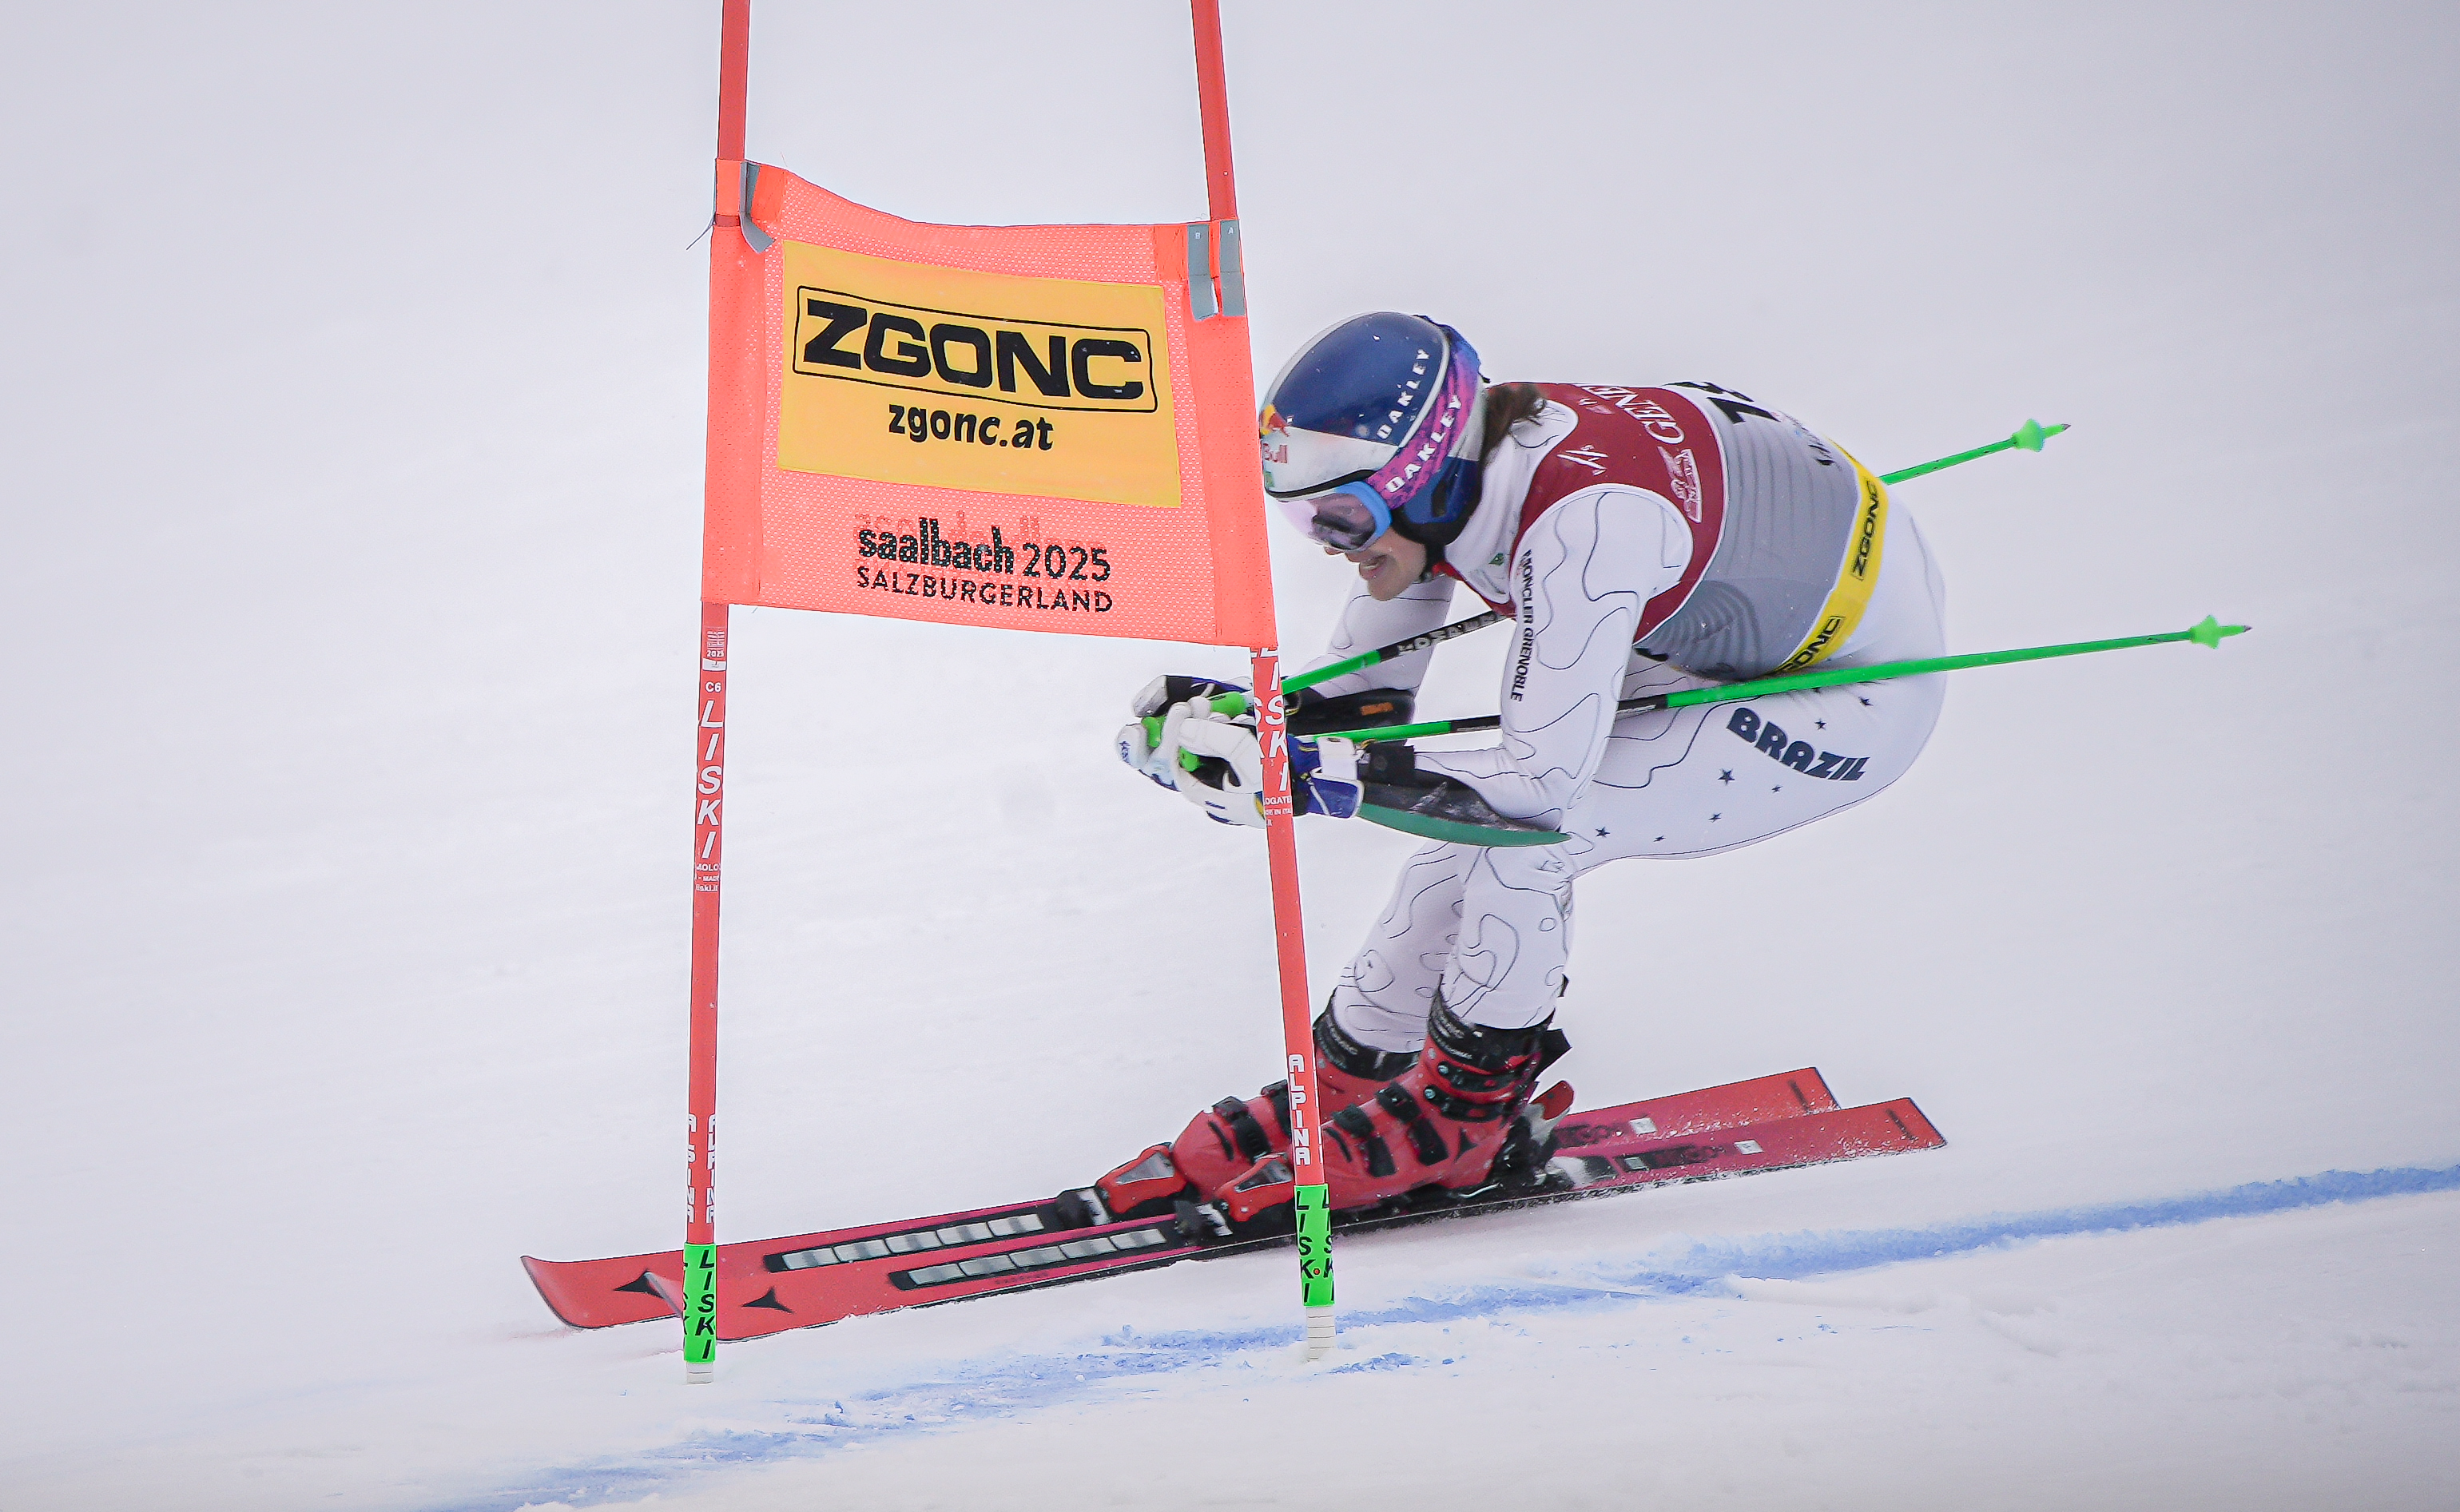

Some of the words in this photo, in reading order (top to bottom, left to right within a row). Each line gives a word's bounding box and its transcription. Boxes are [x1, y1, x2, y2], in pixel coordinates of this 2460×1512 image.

[803, 299, 1143, 399] ZGONC
[1376, 348, 1429, 439] OAKLEY
[888, 403, 1055, 450] zgonc.at
[1385, 394, 1461, 493] OAKLEY
[859, 517, 1014, 574] saalbach
[1023, 542, 1111, 581] 2025
[1851, 480, 1880, 577] ZGONC
[856, 566, 1113, 613] SALZBURGERLAND
[1520, 549, 1534, 624] MONCLER
[705, 681, 722, 693] C6
[1510, 627, 1535, 702] GRENOBLE
[697, 700, 724, 859] LISKI
[1726, 707, 1870, 781] BRAZIL
[1287, 1054, 1310, 1166] ALPINA
[1296, 1190, 1316, 1303] LISKI
[695, 1249, 716, 1359] LISKI
